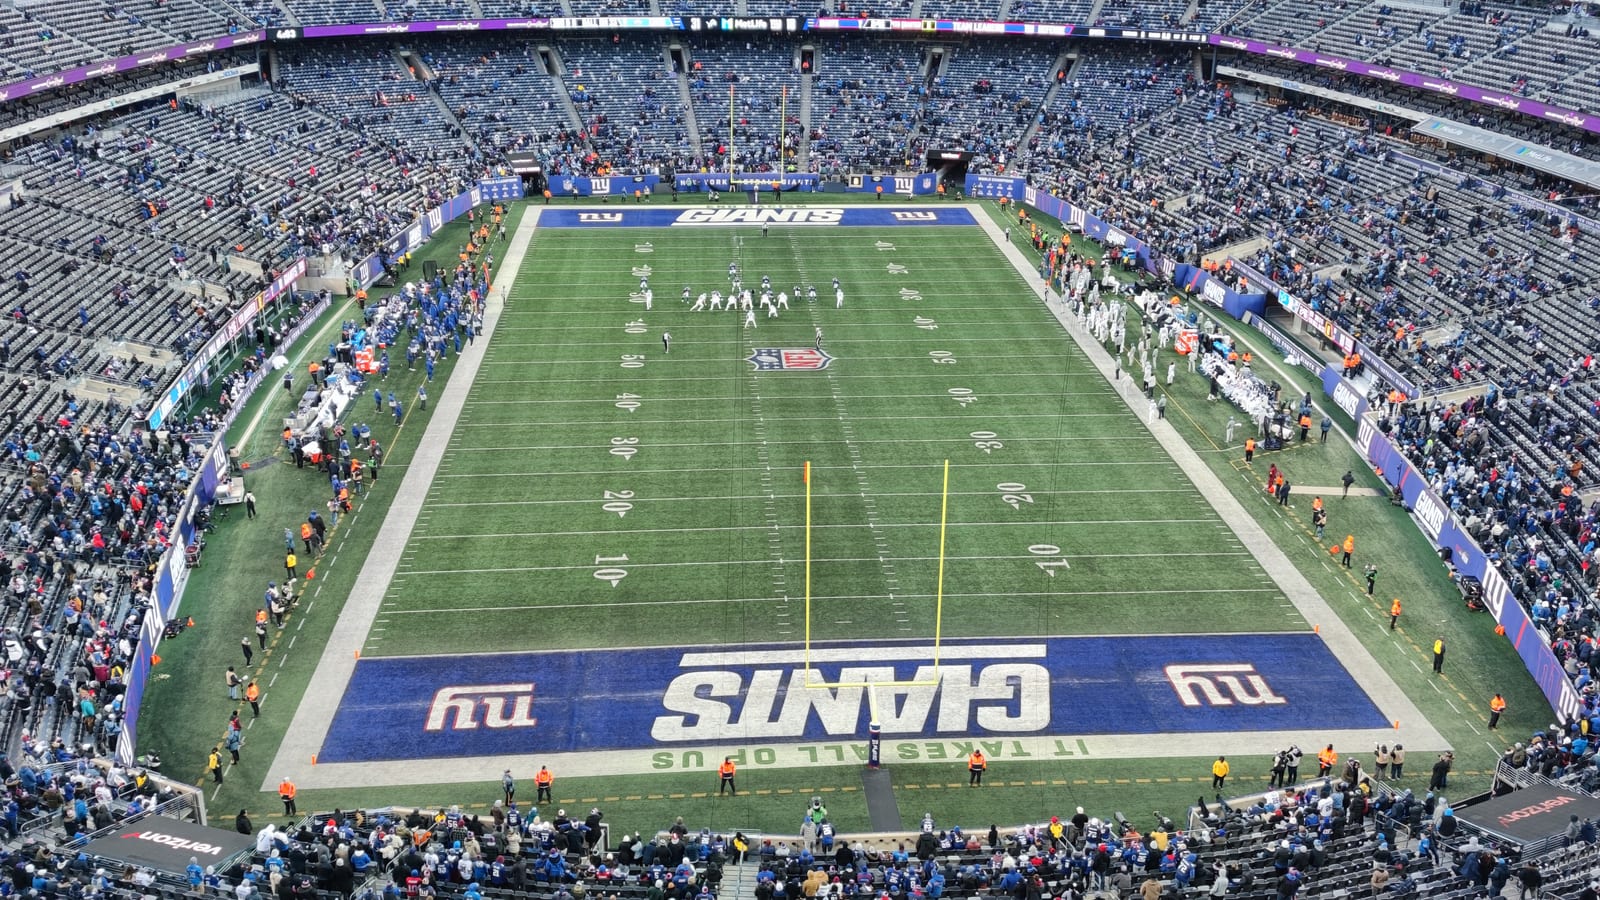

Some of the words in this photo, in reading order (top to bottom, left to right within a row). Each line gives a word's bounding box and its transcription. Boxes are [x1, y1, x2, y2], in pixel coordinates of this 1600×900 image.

[735, 19, 767, 30] MetLife
[590, 178, 610, 194] ny
[894, 177, 914, 194] ny
[578, 212, 623, 222] ny
[676, 208, 845, 222] GIANTS
[891, 211, 937, 221] ny
[620, 354, 645, 368] 50
[929, 350, 957, 364] 50
[615, 393, 642, 408] 40
[948, 388, 978, 403] 40
[1333, 381, 1359, 417] GIANTS
[609, 437, 639, 456] 30
[970, 431, 1003, 449] 30
[602, 489, 635, 512] 20
[997, 482, 1034, 503] 20
[1415, 489, 1445, 535] GIANTS
[593, 553, 629, 580] 10
[1028, 544, 1071, 570] 10
[1163, 663, 1288, 706] ny
[424, 683, 538, 731] ny
[650, 663, 1051, 742] GIANTS
[798, 743, 870, 763] ALL
[898, 739, 1032, 761] TAKES
[1053, 738, 1089, 756] IT
[652, 750, 704, 770] US
[732, 748, 776, 766] OF
[1501, 796, 1577, 823] verizon
[138, 831, 223, 856] verizon
